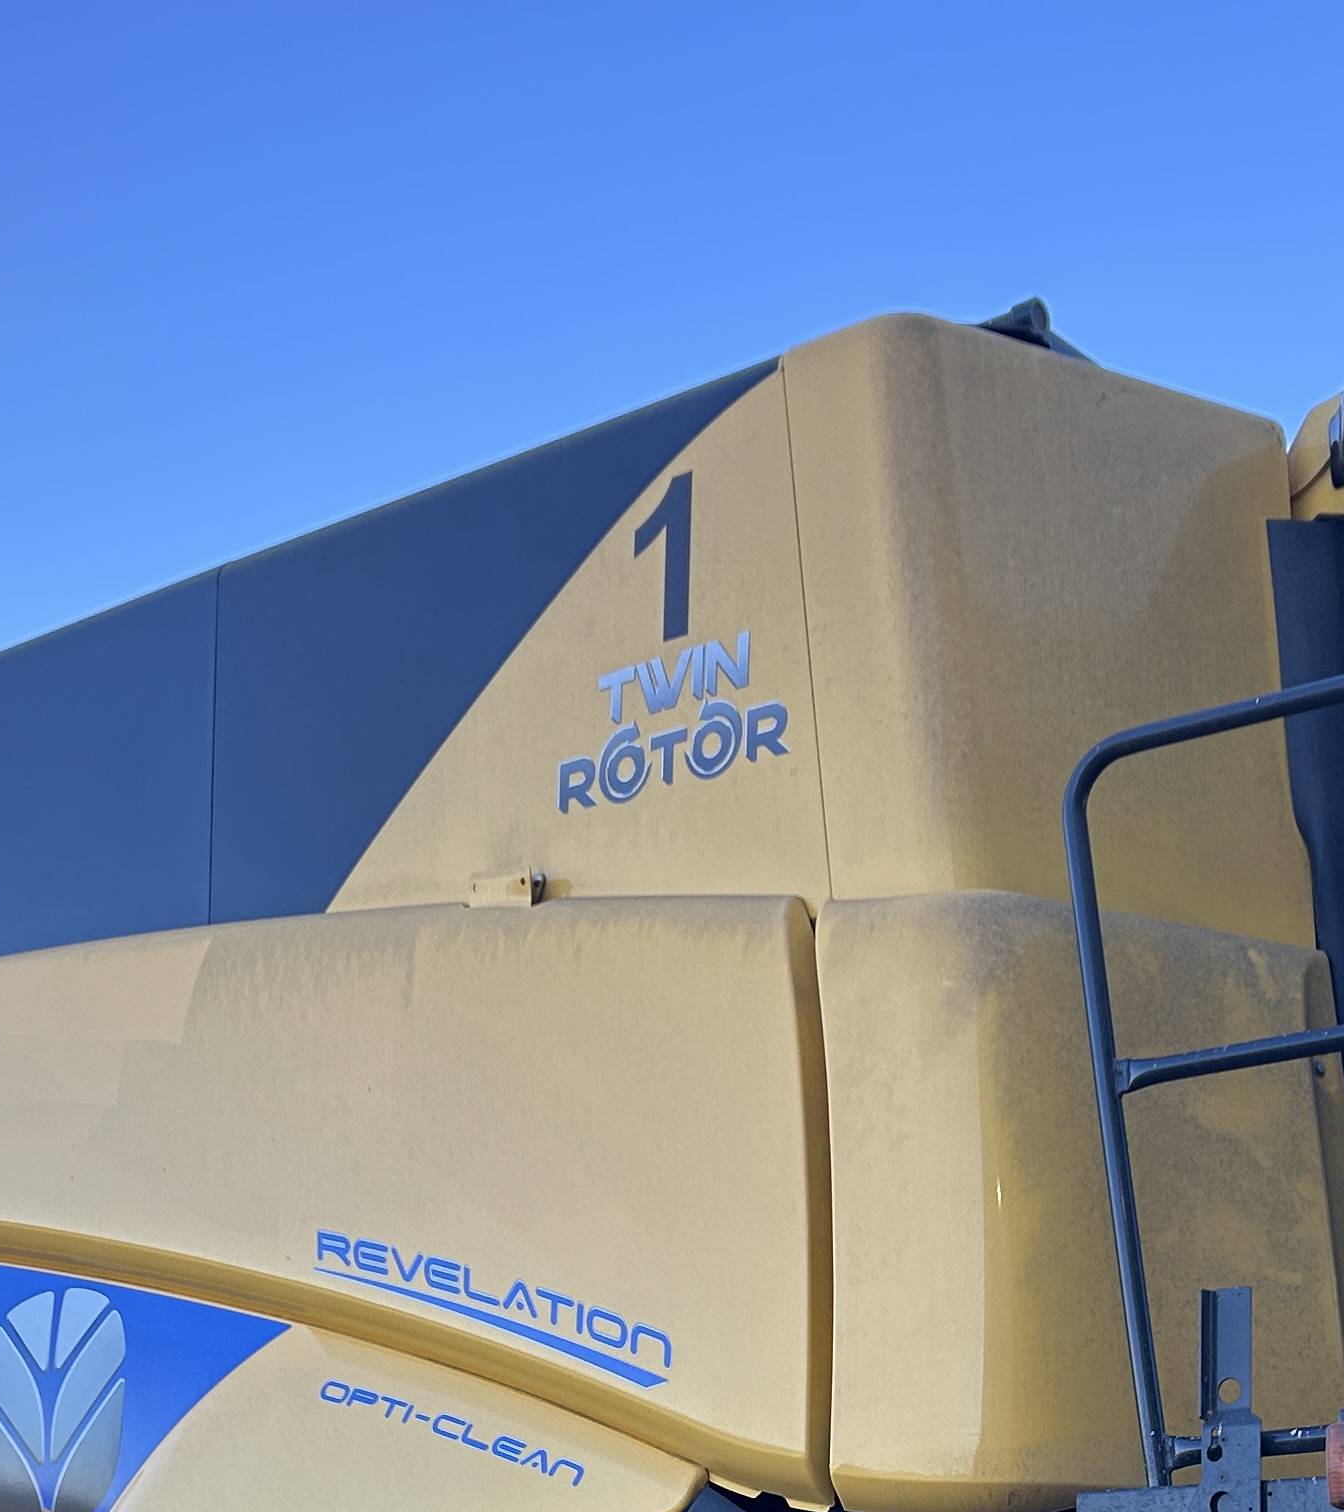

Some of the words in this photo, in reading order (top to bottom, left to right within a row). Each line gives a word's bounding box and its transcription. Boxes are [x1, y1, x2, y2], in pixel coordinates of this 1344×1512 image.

[634, 470, 693, 642] 1
[598, 630, 750, 724] TWIN
[558, 699, 791, 815] ROTOR
[316, 1229, 672, 1368] REVELATION
[320, 1380, 584, 1487] OPTI-CLEAN
